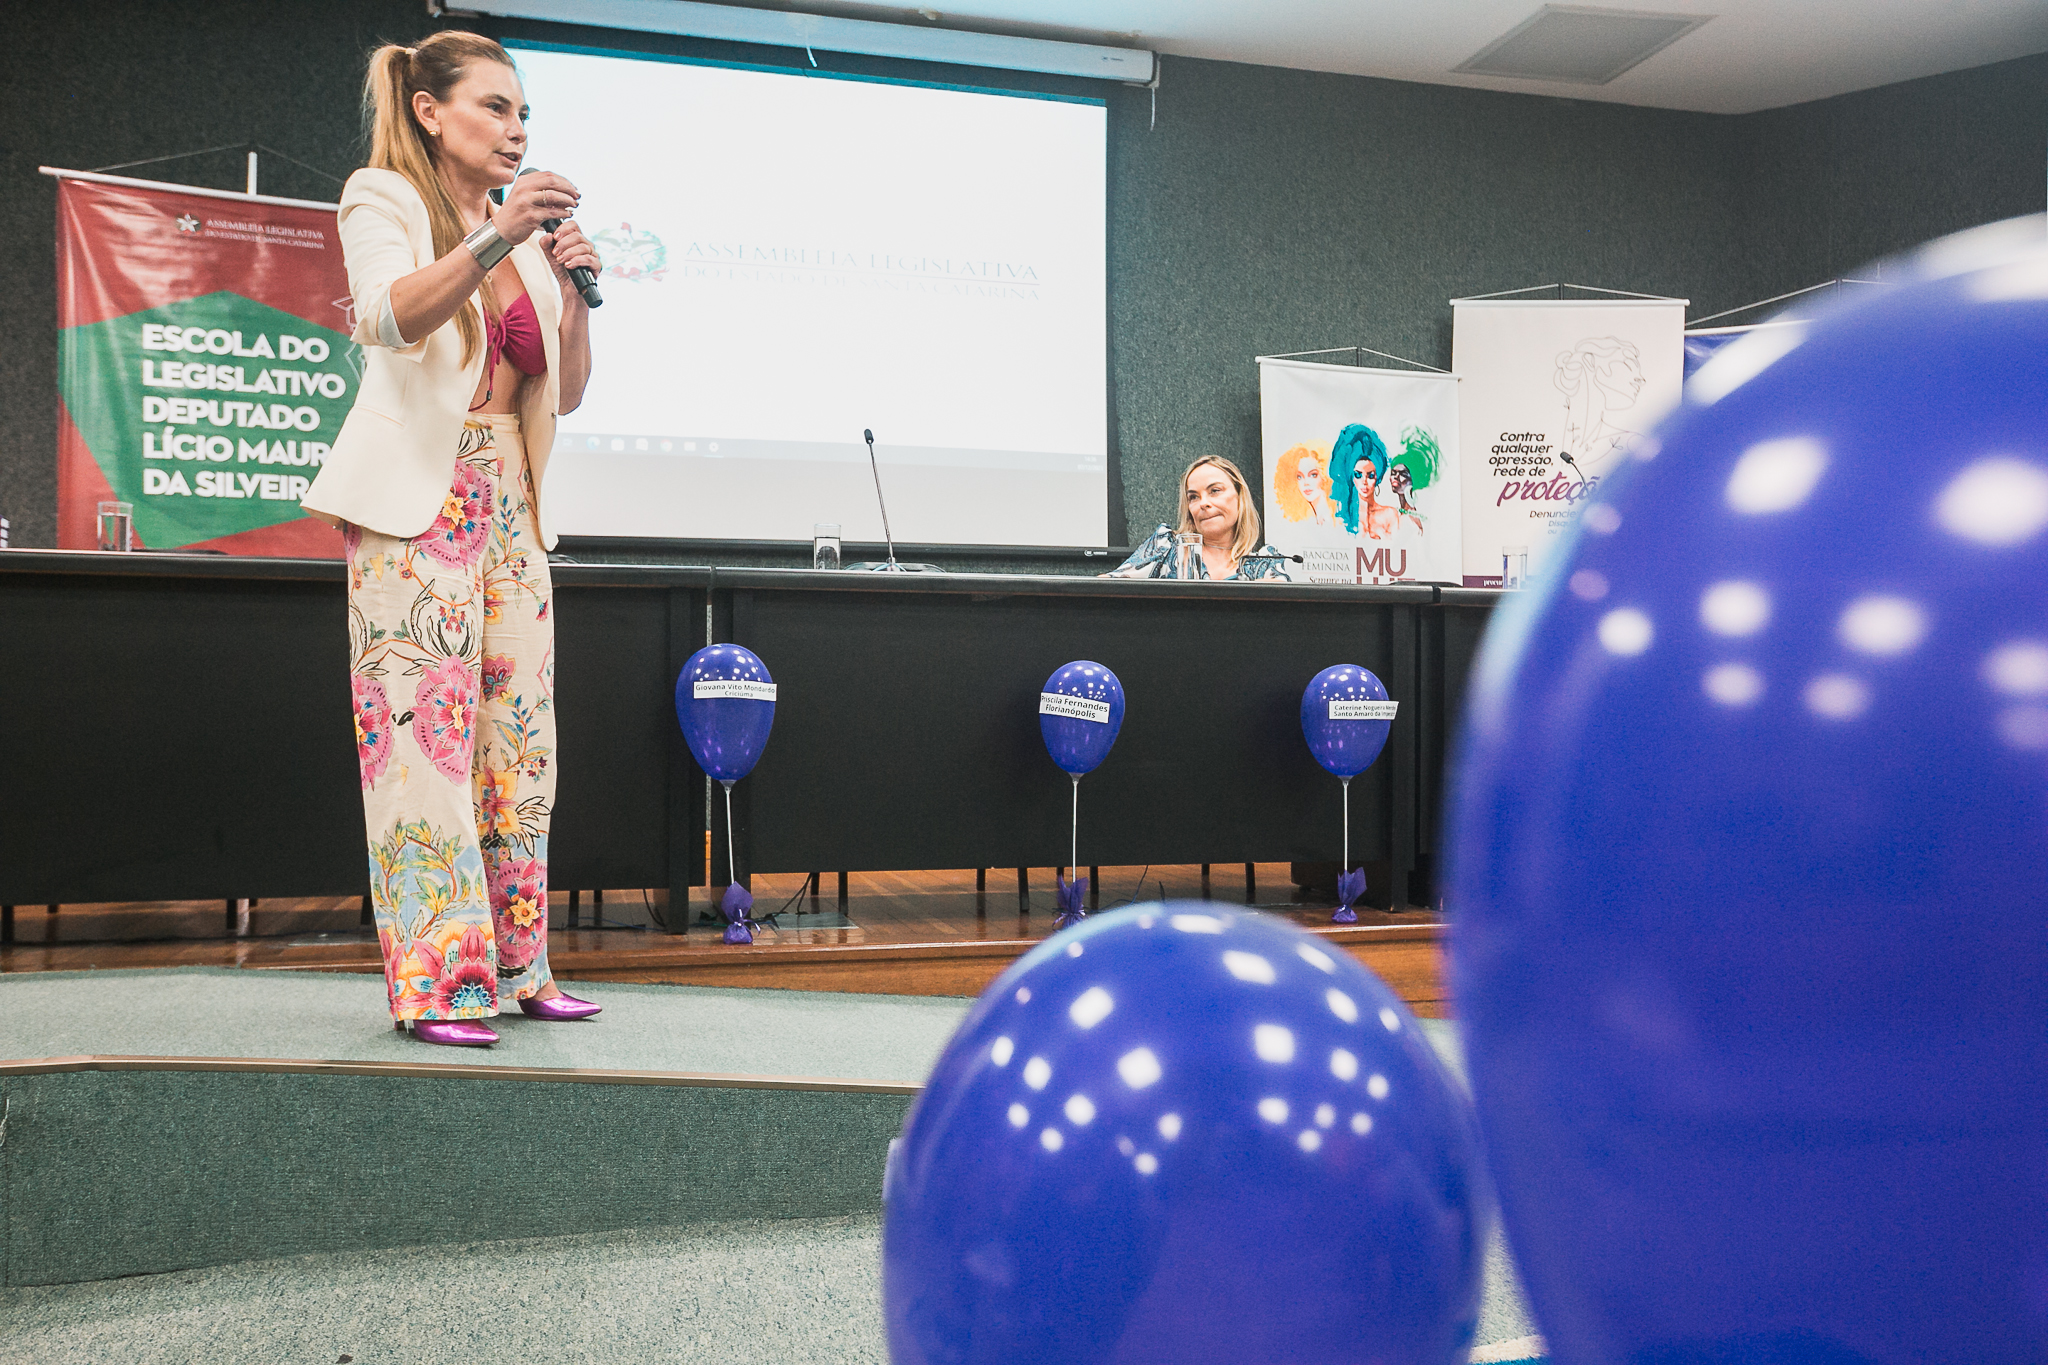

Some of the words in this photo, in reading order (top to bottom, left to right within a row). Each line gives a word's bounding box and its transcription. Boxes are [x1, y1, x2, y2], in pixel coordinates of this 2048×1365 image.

[686, 240, 858, 267] ASSEMBLEIA
[870, 252, 1039, 281] LEGISLATIVA
[684, 265, 721, 278] DO
[142, 322, 276, 360] ESCOLA
[280, 334, 331, 364] DO
[142, 360, 347, 400] LEGISLATIVO
[142, 396, 321, 433] DEPUTADO
[1500, 431, 1546, 442] Contra
[142, 426, 235, 463] LÍCIO
[238, 437, 331, 468] MAUR
[1491, 443, 1554, 456] qualquer
[1488, 454, 1554, 467] opressão,
[1493, 466, 1526, 477] rede
[1528, 466, 1546, 477] de
[143, 468, 193, 498] DA
[195, 470, 310, 501] SILVEIR
[1496, 471, 1601, 507] proteçã
[1303, 550, 1350, 561] BANCADA
[1356, 546, 1407, 577] MU
[1301, 560, 1351, 572] FEMININA
[1045, 703, 1096, 719] Florianópolis
[1063, 698, 1108, 713] Fernandes
